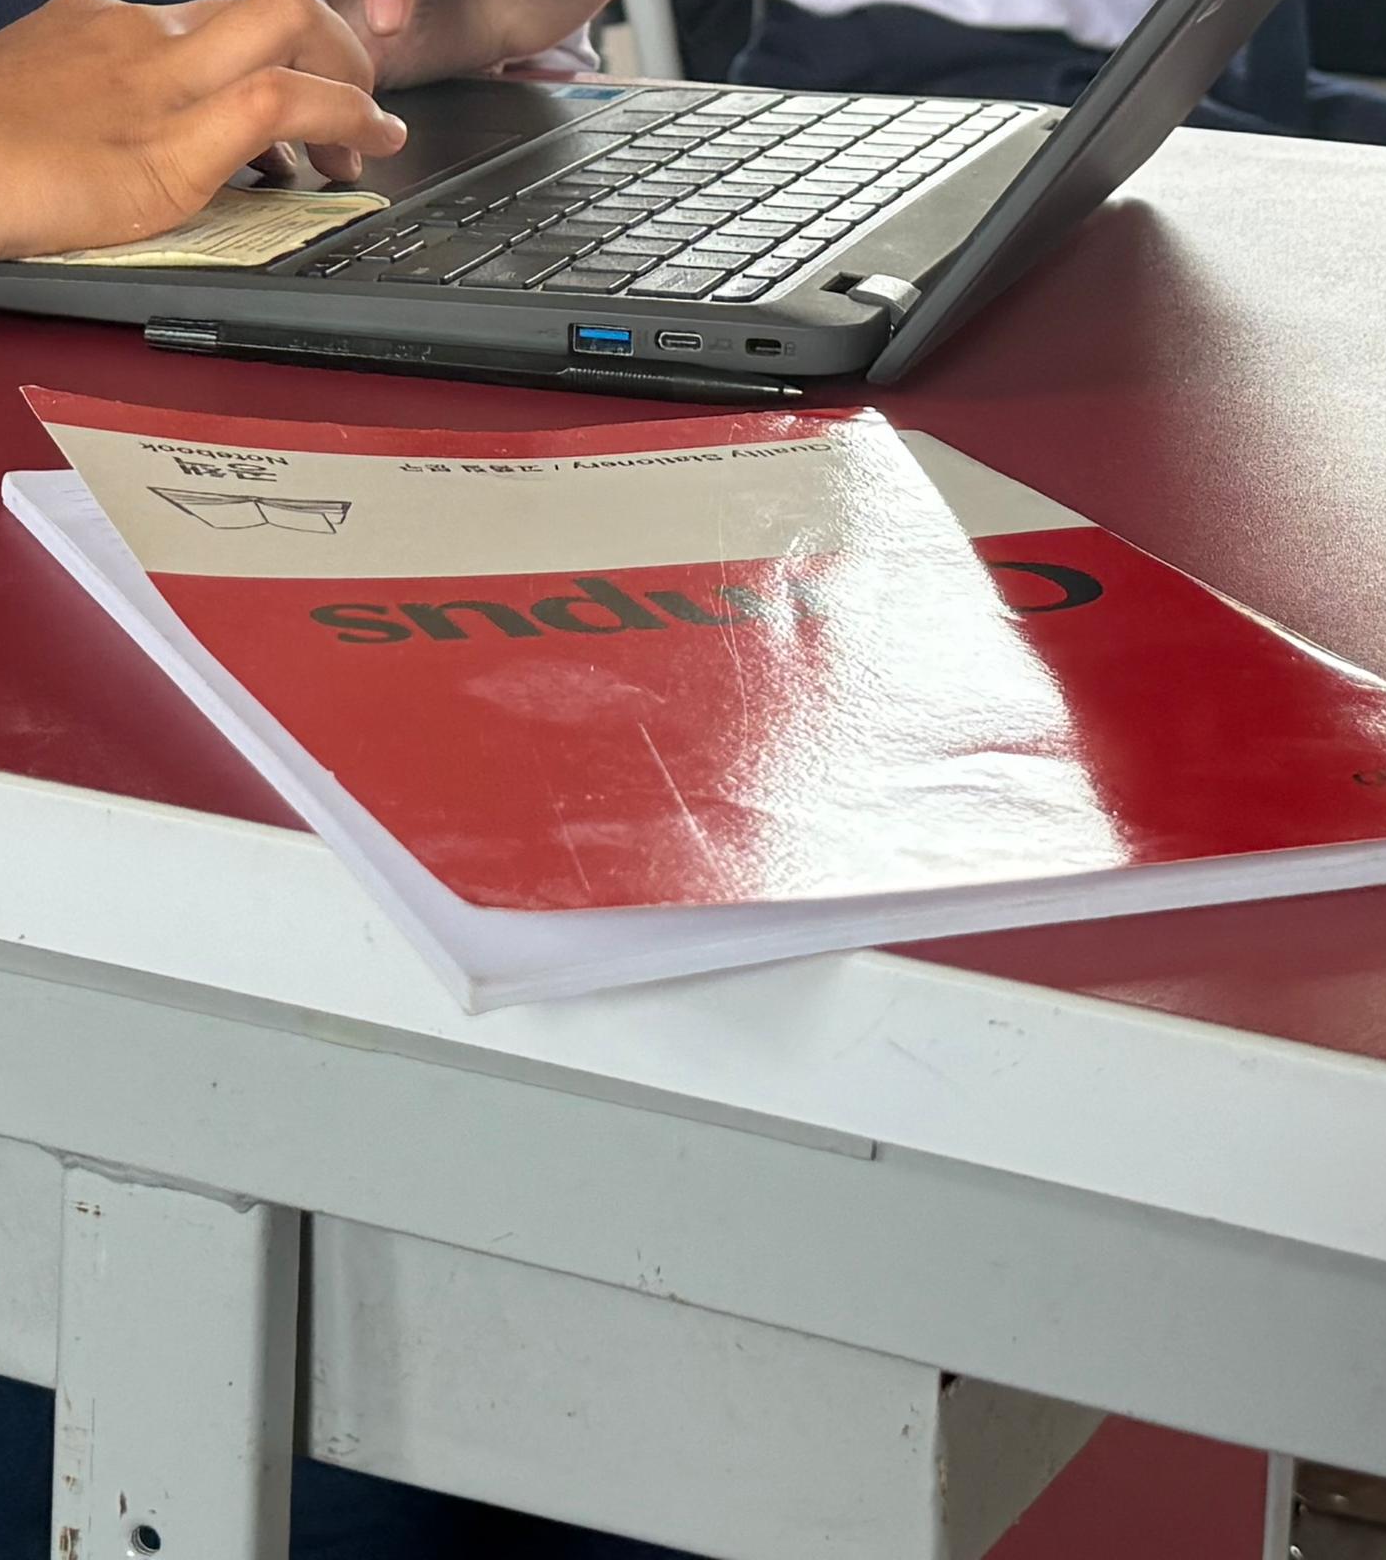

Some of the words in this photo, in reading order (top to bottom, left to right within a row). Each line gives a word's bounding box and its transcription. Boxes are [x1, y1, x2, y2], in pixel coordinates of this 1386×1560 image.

[138, 442, 290, 466] Notebook
[573, 453, 724, 471] Stationery
[172, 456, 277, 482] 공책
[308, 560, 1103, 645] Cmpus
